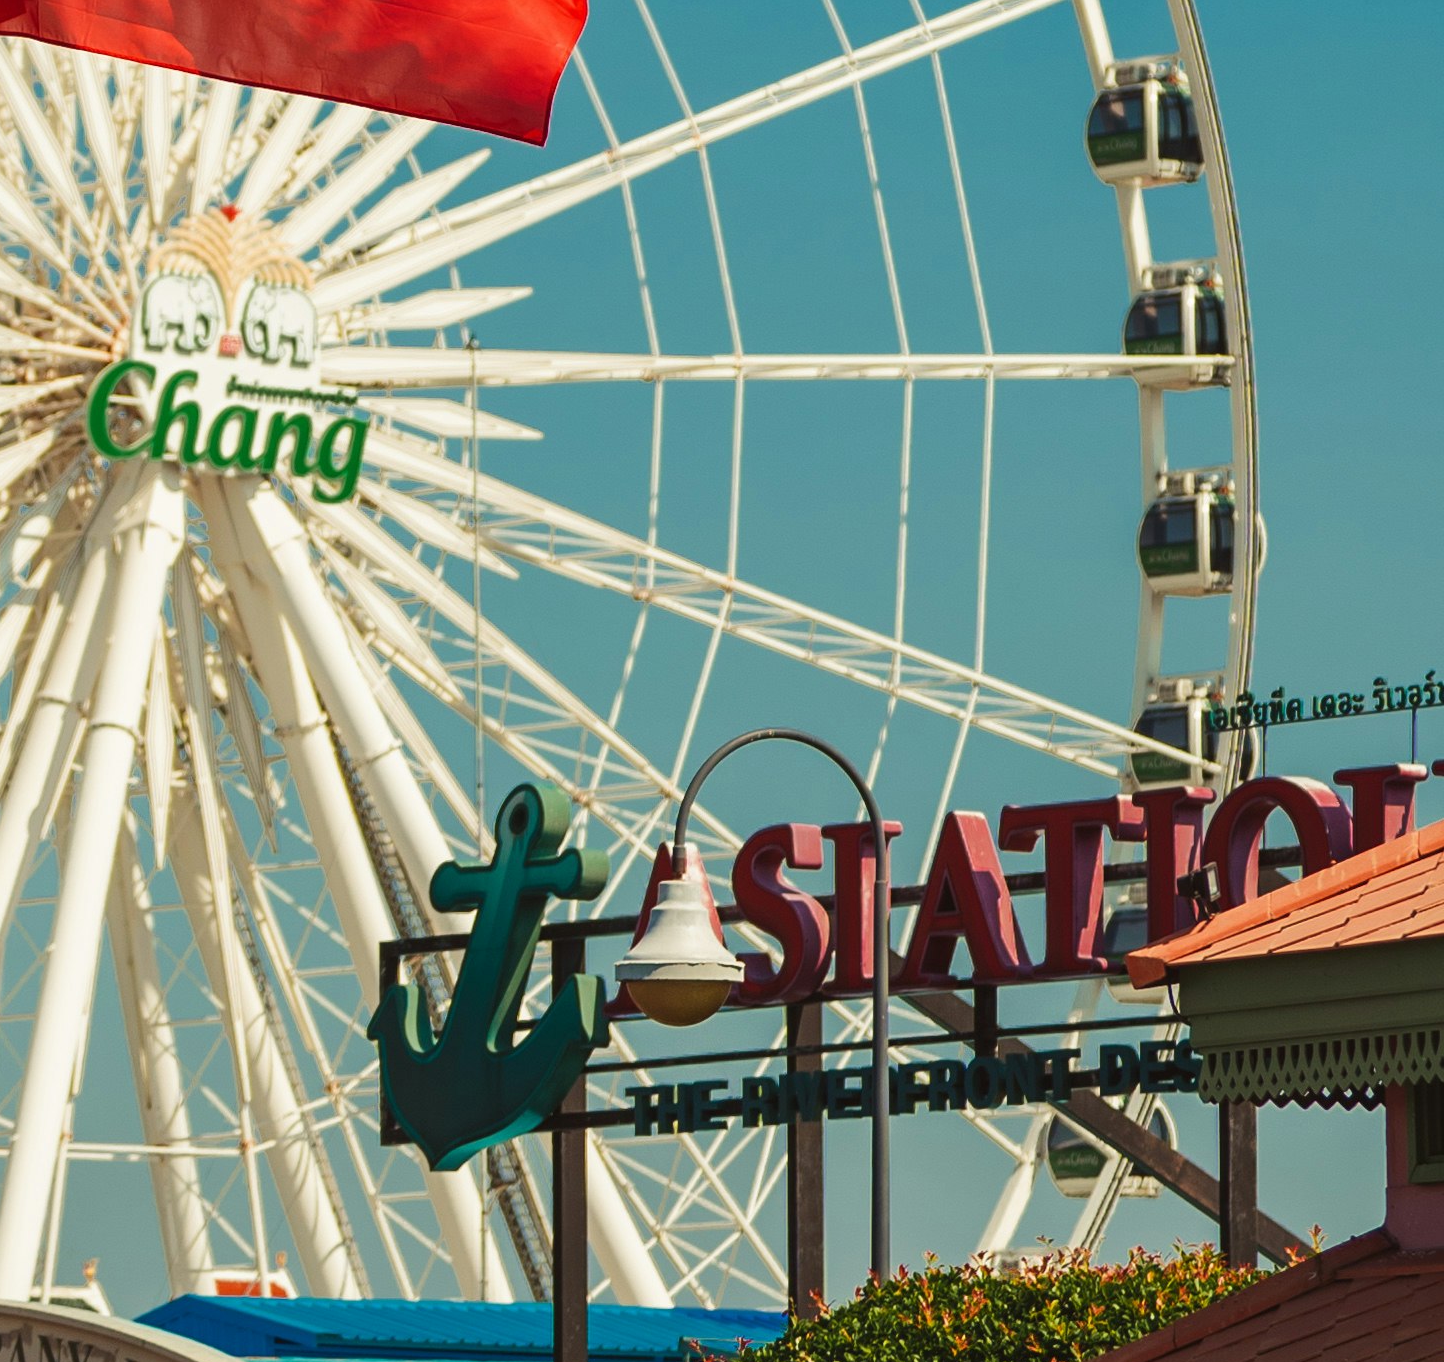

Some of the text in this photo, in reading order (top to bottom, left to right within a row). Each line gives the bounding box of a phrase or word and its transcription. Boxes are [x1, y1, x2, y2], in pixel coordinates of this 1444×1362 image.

[87, 359, 371, 504] Chang
[625, 1079, 729, 1136] THE
[1100, 1039, 1203, 1096] DES
